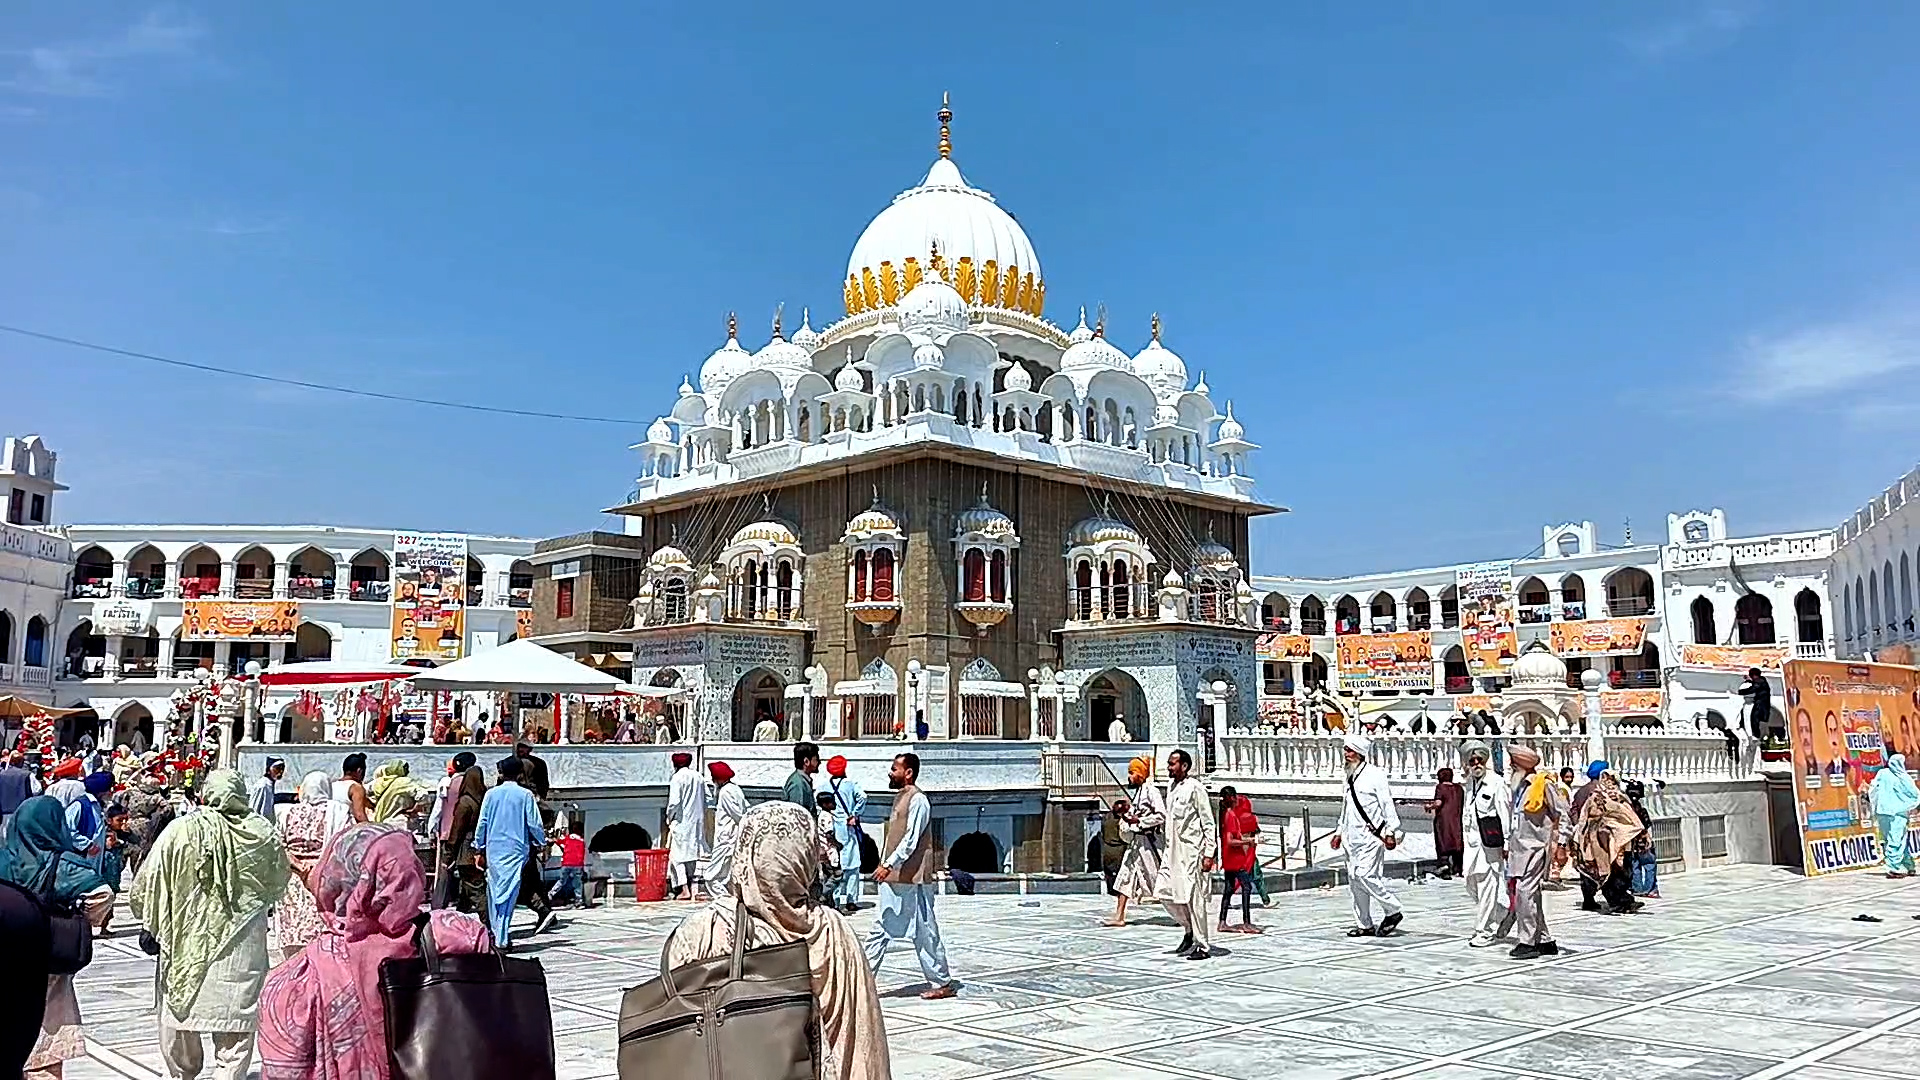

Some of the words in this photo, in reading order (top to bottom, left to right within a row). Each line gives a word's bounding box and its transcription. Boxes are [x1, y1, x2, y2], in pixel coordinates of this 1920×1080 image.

[397, 535, 417, 545] 327
[408, 559, 452, 567] WELCOME
[1344, 680, 1382, 688] WELCOME
[1393, 679, 1429, 687] PAKISTAN
[335, 729, 354, 738] PCO
[1846, 734, 1881, 749] WELCOME
[1810, 835, 1878, 870] WELCOME
